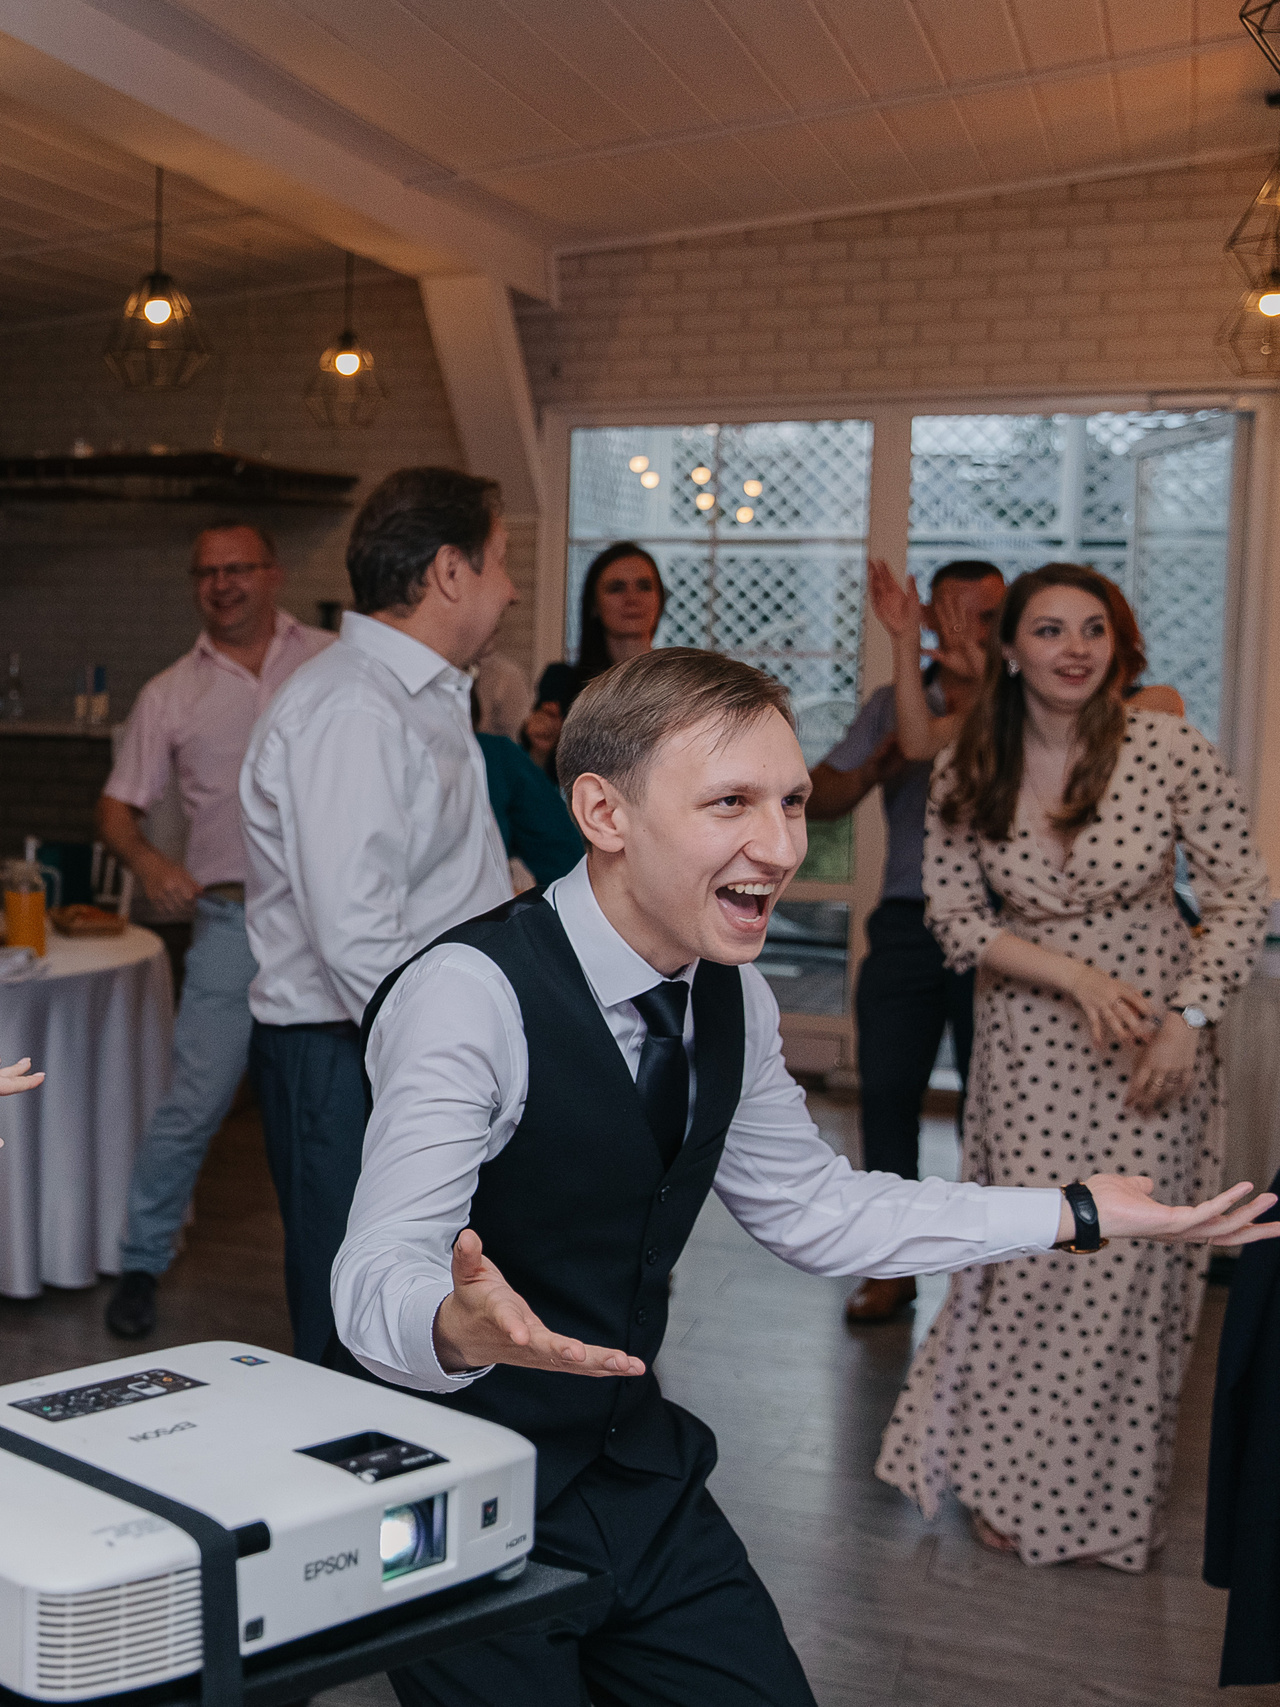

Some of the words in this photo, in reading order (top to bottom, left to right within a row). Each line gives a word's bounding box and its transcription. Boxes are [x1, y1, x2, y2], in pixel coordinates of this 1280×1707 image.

[129, 1421, 197, 1443] EPSON
[506, 1534, 527, 1550] HDMI
[304, 1549, 360, 1581] EPSON
